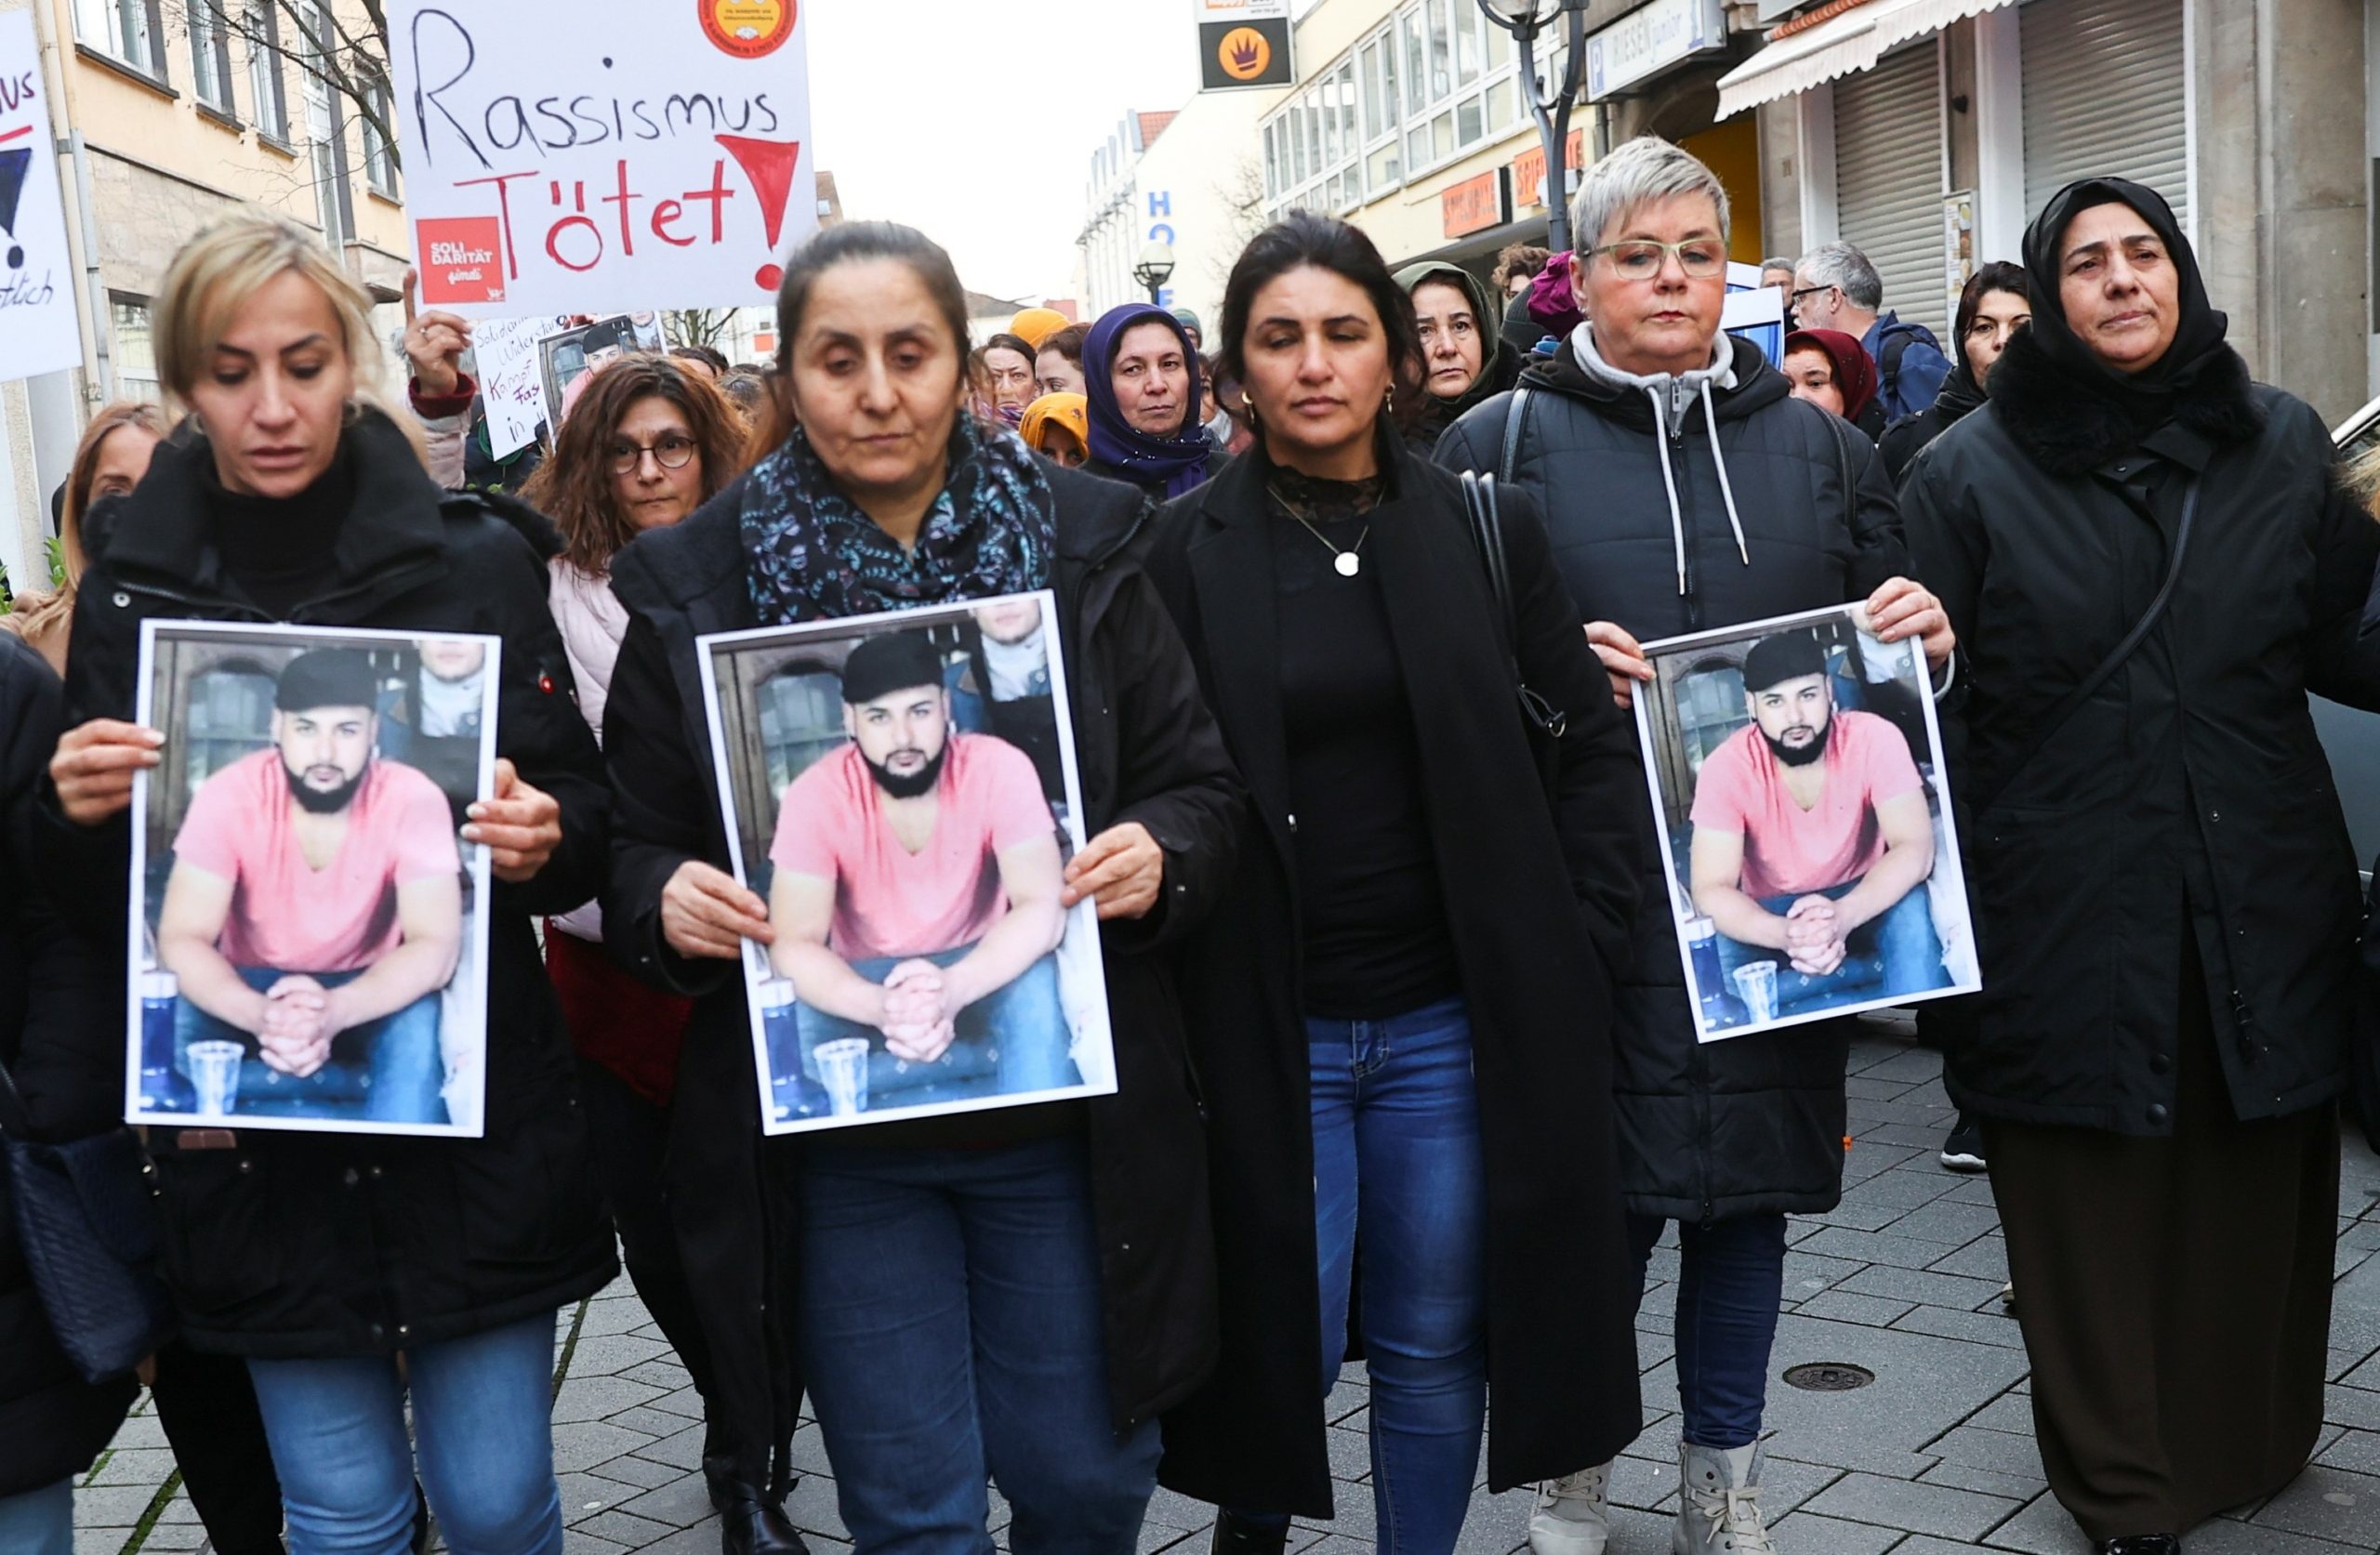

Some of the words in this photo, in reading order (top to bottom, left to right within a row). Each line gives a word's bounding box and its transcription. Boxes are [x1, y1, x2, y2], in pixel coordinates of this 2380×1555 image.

[411, 8, 778, 170] Rassismus
[430, 242, 465, 254] SOLI
[431, 248, 493, 265] DARITÄT
